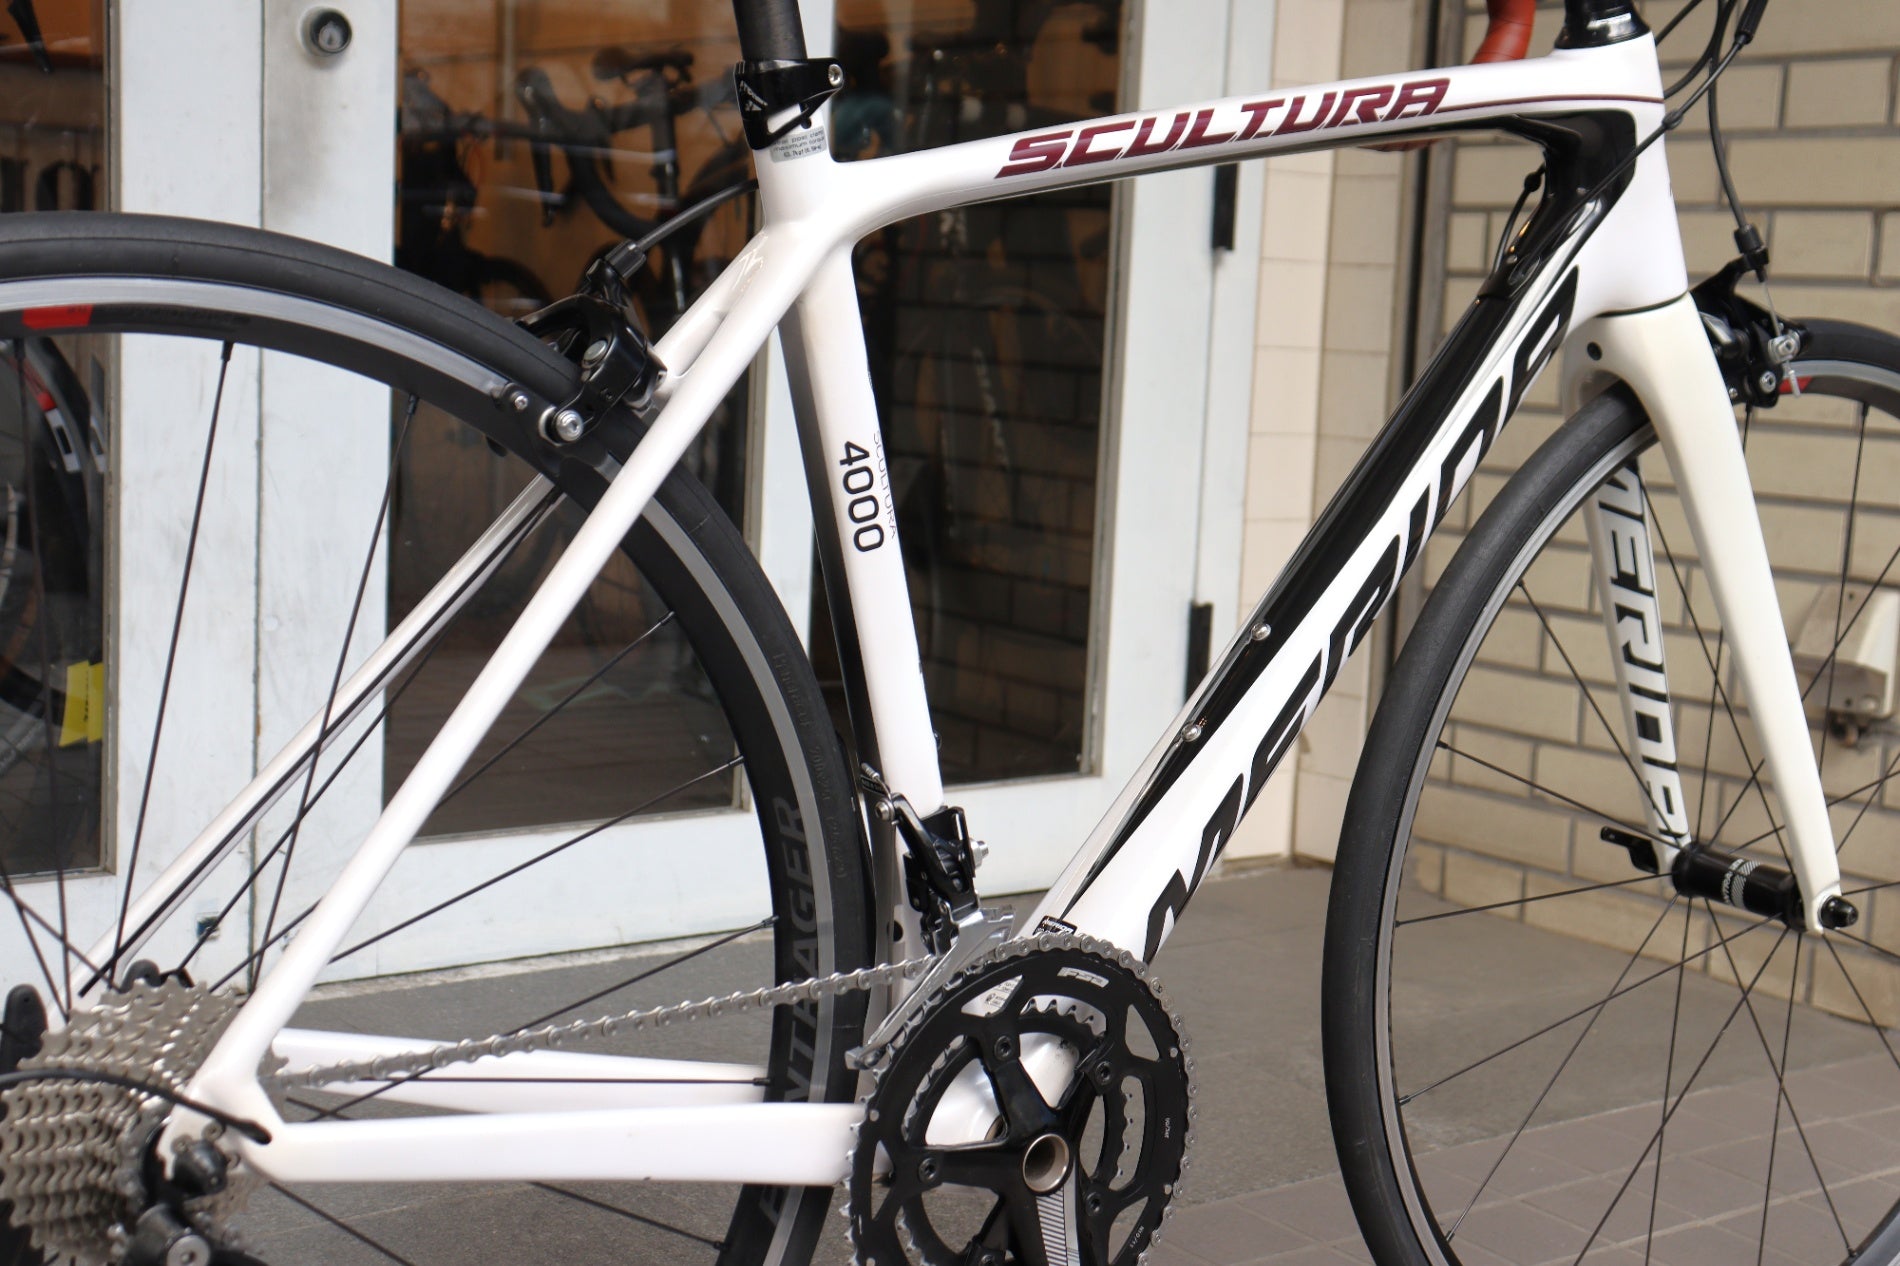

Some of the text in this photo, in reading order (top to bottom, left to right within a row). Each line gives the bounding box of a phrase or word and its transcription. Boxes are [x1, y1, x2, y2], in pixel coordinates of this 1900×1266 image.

[994, 78, 1451, 179] SCULTURA
[839, 441, 885, 553] 4000
[873, 430, 897, 540] SCULTURA
